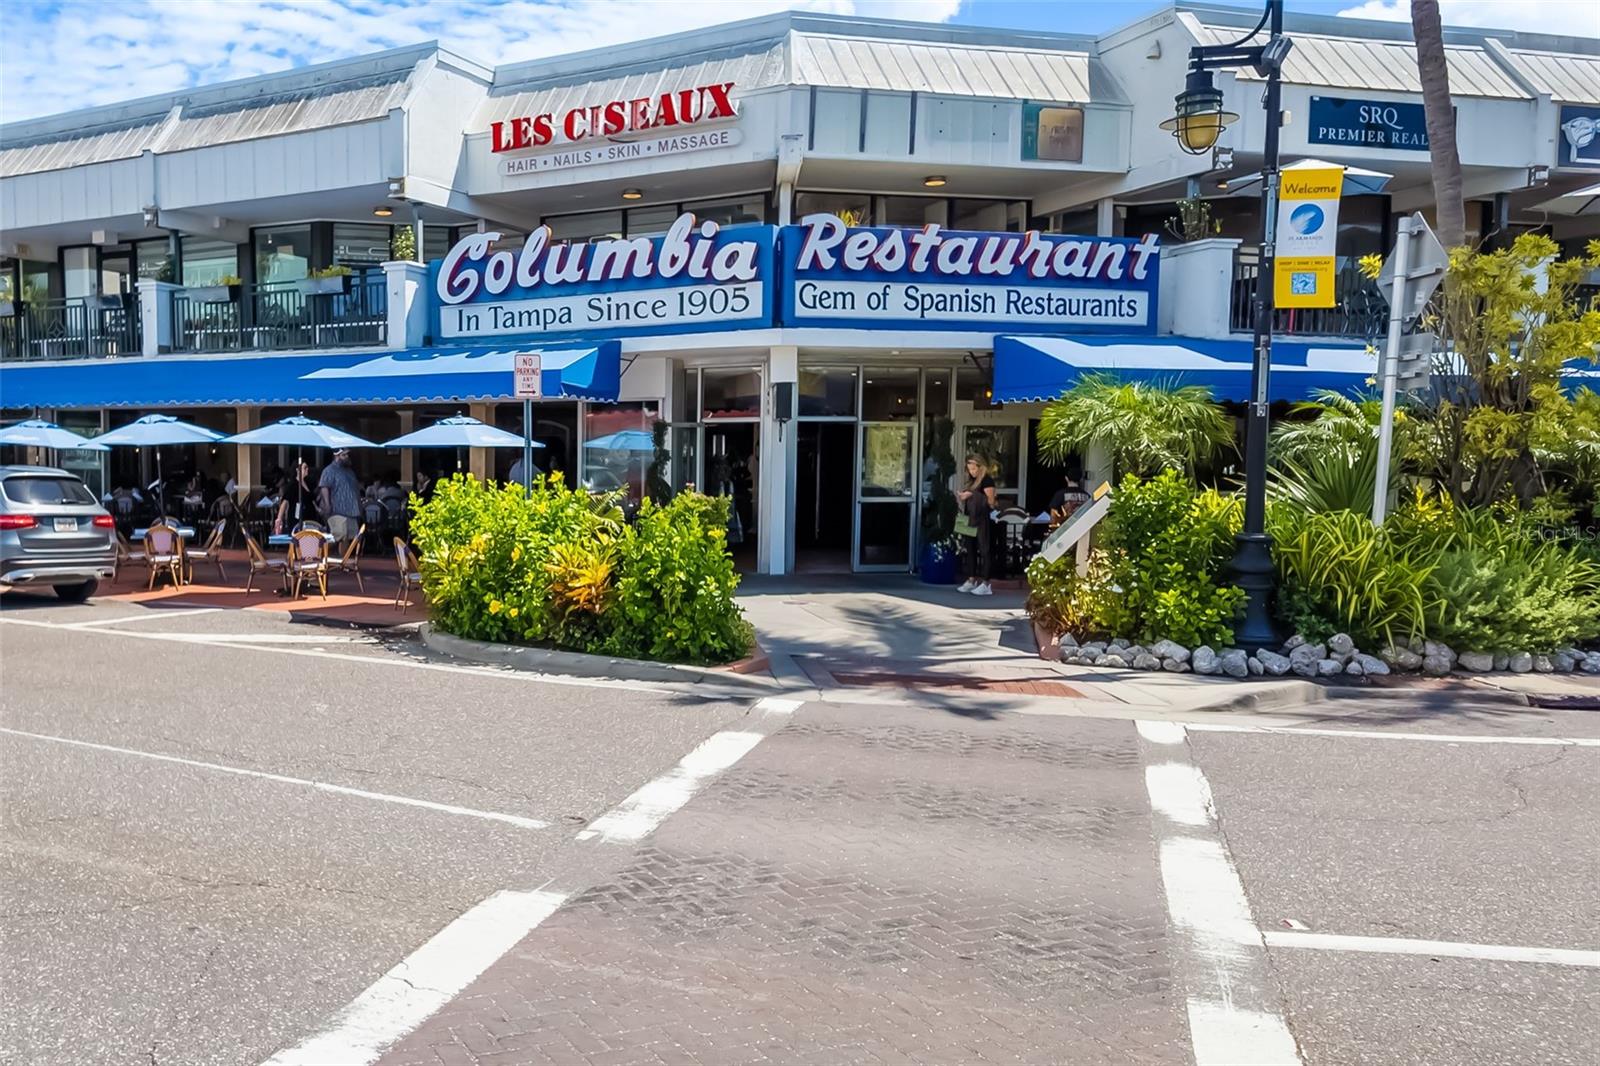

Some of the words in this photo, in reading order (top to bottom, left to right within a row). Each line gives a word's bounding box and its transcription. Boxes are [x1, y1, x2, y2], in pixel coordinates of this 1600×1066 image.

[490, 113, 553, 153] LES
[564, 82, 737, 141] CISEAUX
[1359, 105, 1404, 129] SRQ
[507, 158, 538, 173] HAIR
[553, 151, 592, 167] NAILS
[608, 143, 640, 159] SKIN
[657, 132, 730, 153] MASSAGE
[1318, 127, 1385, 143] PREMIER
[1391, 132, 1429, 145] REAL
[1285, 183, 1337, 194] Welcome
[437, 212, 759, 305] Columbia
[796, 212, 1160, 280] Restaurant
[456, 309, 480, 333] In
[488, 305, 573, 332] Tampa
[586, 296, 667, 323] Since
[677, 287, 750, 317] 1905
[798, 282, 856, 311] Gem
[866, 284, 891, 312] of
[903, 288, 996, 319] Spanish
[1005, 289, 1138, 318] Restaurants
[516, 367, 539, 376] PARKING
[522, 358, 533, 367] NO
